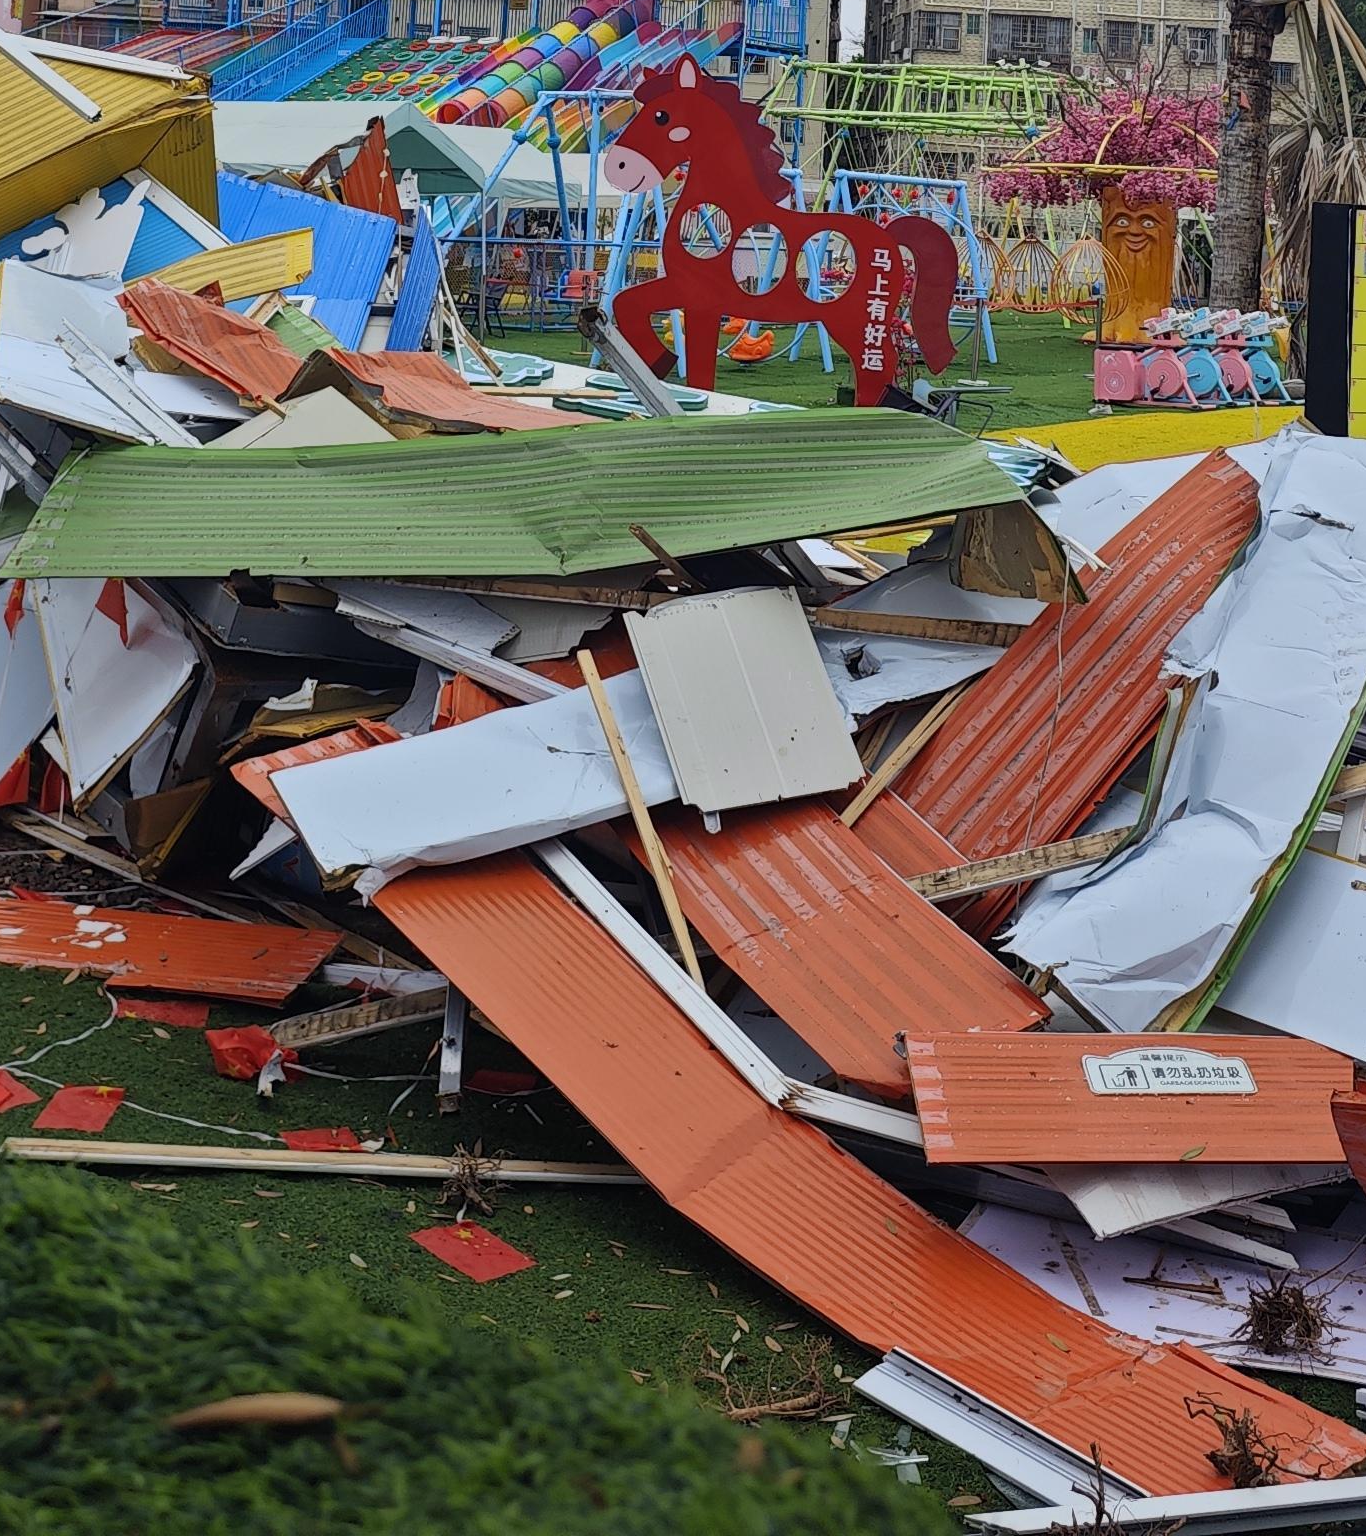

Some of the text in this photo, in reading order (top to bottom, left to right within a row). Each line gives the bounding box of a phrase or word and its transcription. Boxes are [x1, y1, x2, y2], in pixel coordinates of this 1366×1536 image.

[861, 249, 892, 371] 马上有好运
[1139, 1053, 1188, 1062] 温馨提示
[1151, 1066, 1243, 1079] 请勿乱扔垃圾
